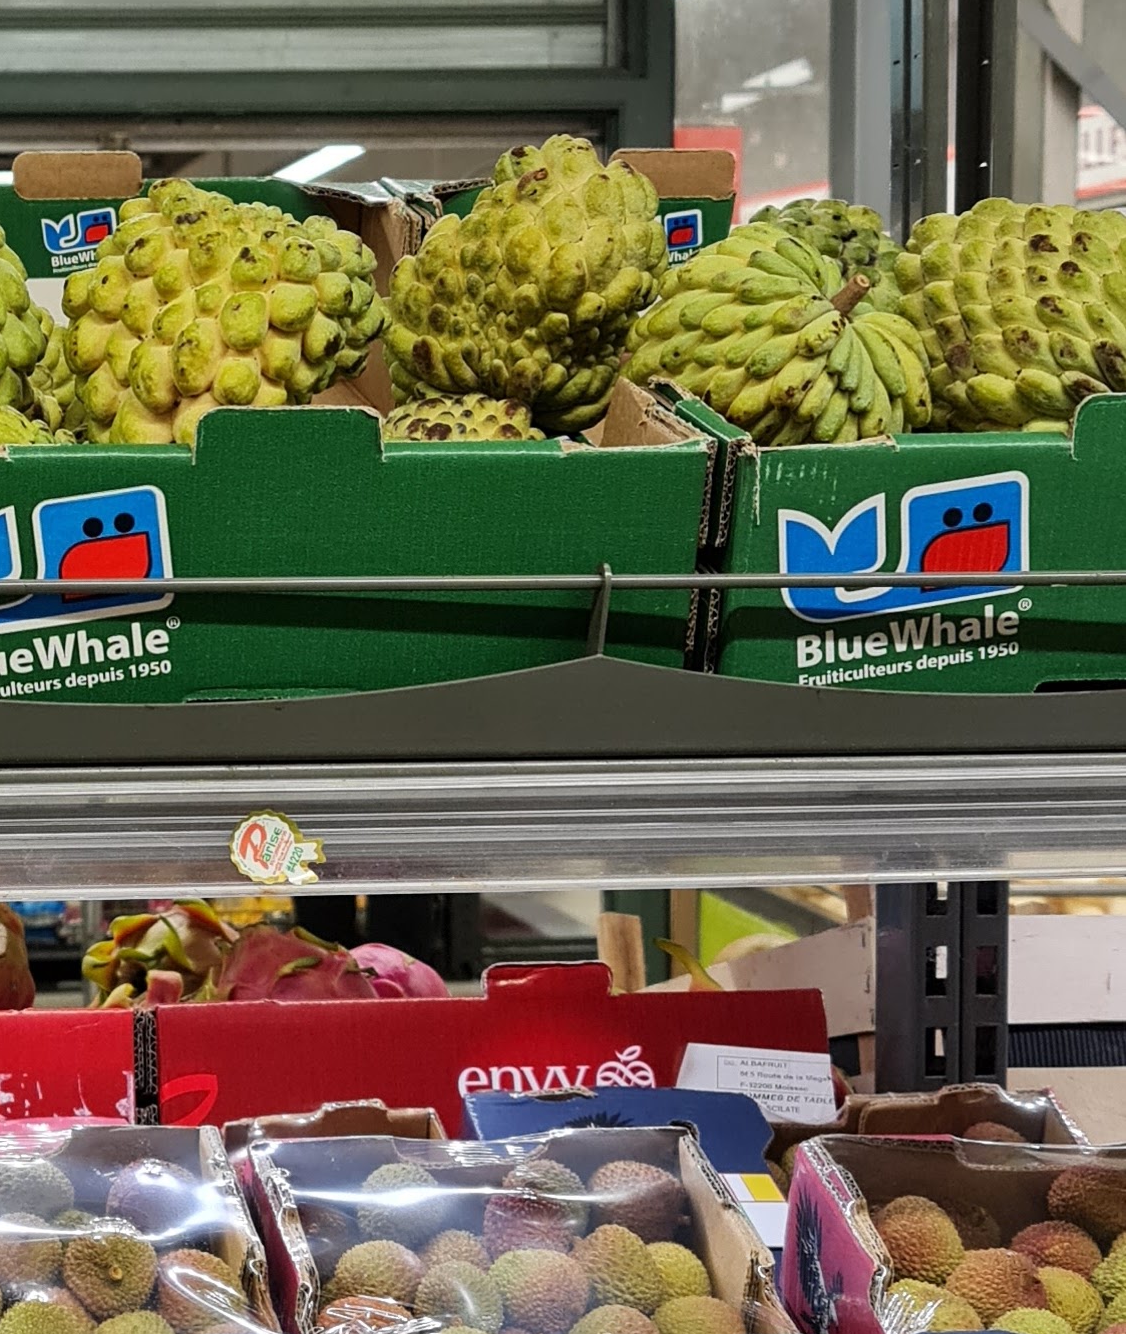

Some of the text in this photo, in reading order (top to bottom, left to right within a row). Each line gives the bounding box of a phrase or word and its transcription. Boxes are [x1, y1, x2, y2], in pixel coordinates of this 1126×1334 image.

[916, 650, 973, 671] depuis
[977, 641, 1019, 660] 1950
[64, 666, 124, 691] depuis
[128, 659, 172, 679] 1950
